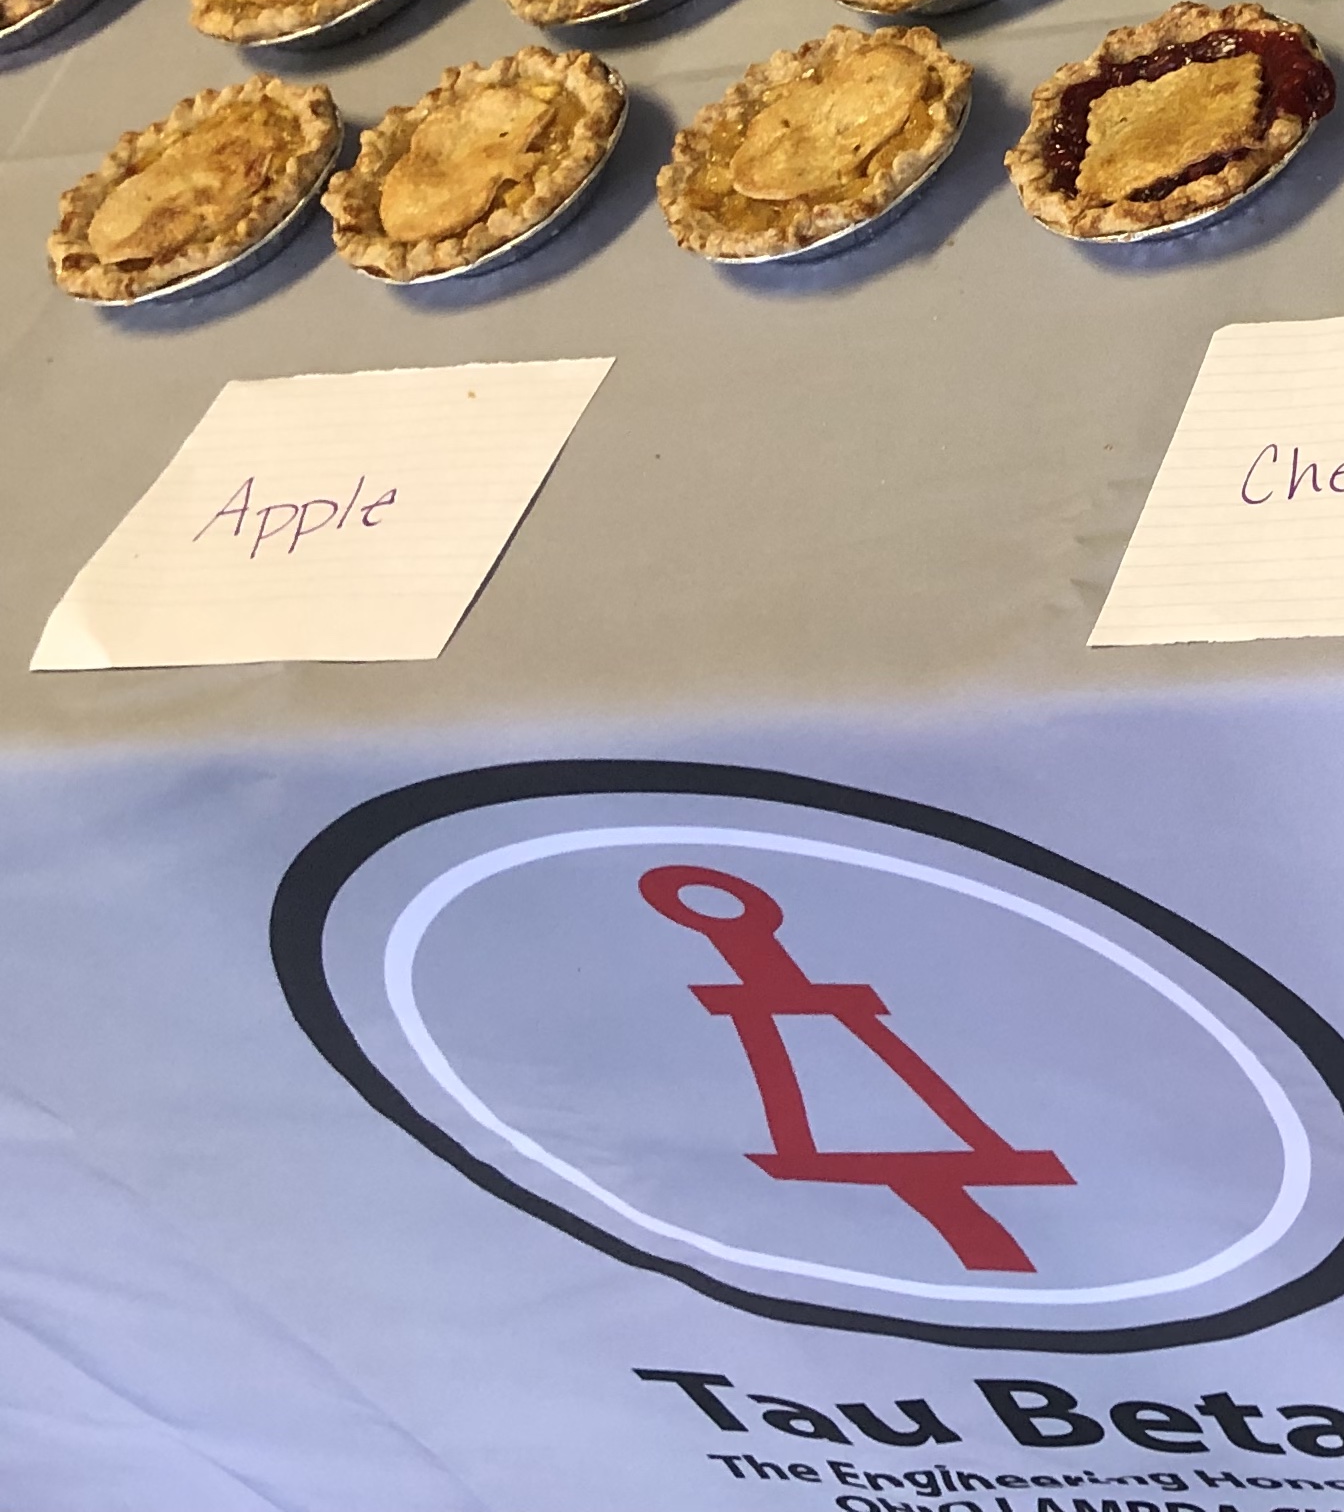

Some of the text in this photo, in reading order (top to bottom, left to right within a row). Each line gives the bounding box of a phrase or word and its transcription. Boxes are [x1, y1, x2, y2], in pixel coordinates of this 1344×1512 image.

[193, 475, 397, 560] Apple
[632, 1368, 963, 1448] Tau
[706, 1453, 822, 1483] The
[826, 1459, 1190, 1497] Engineering
